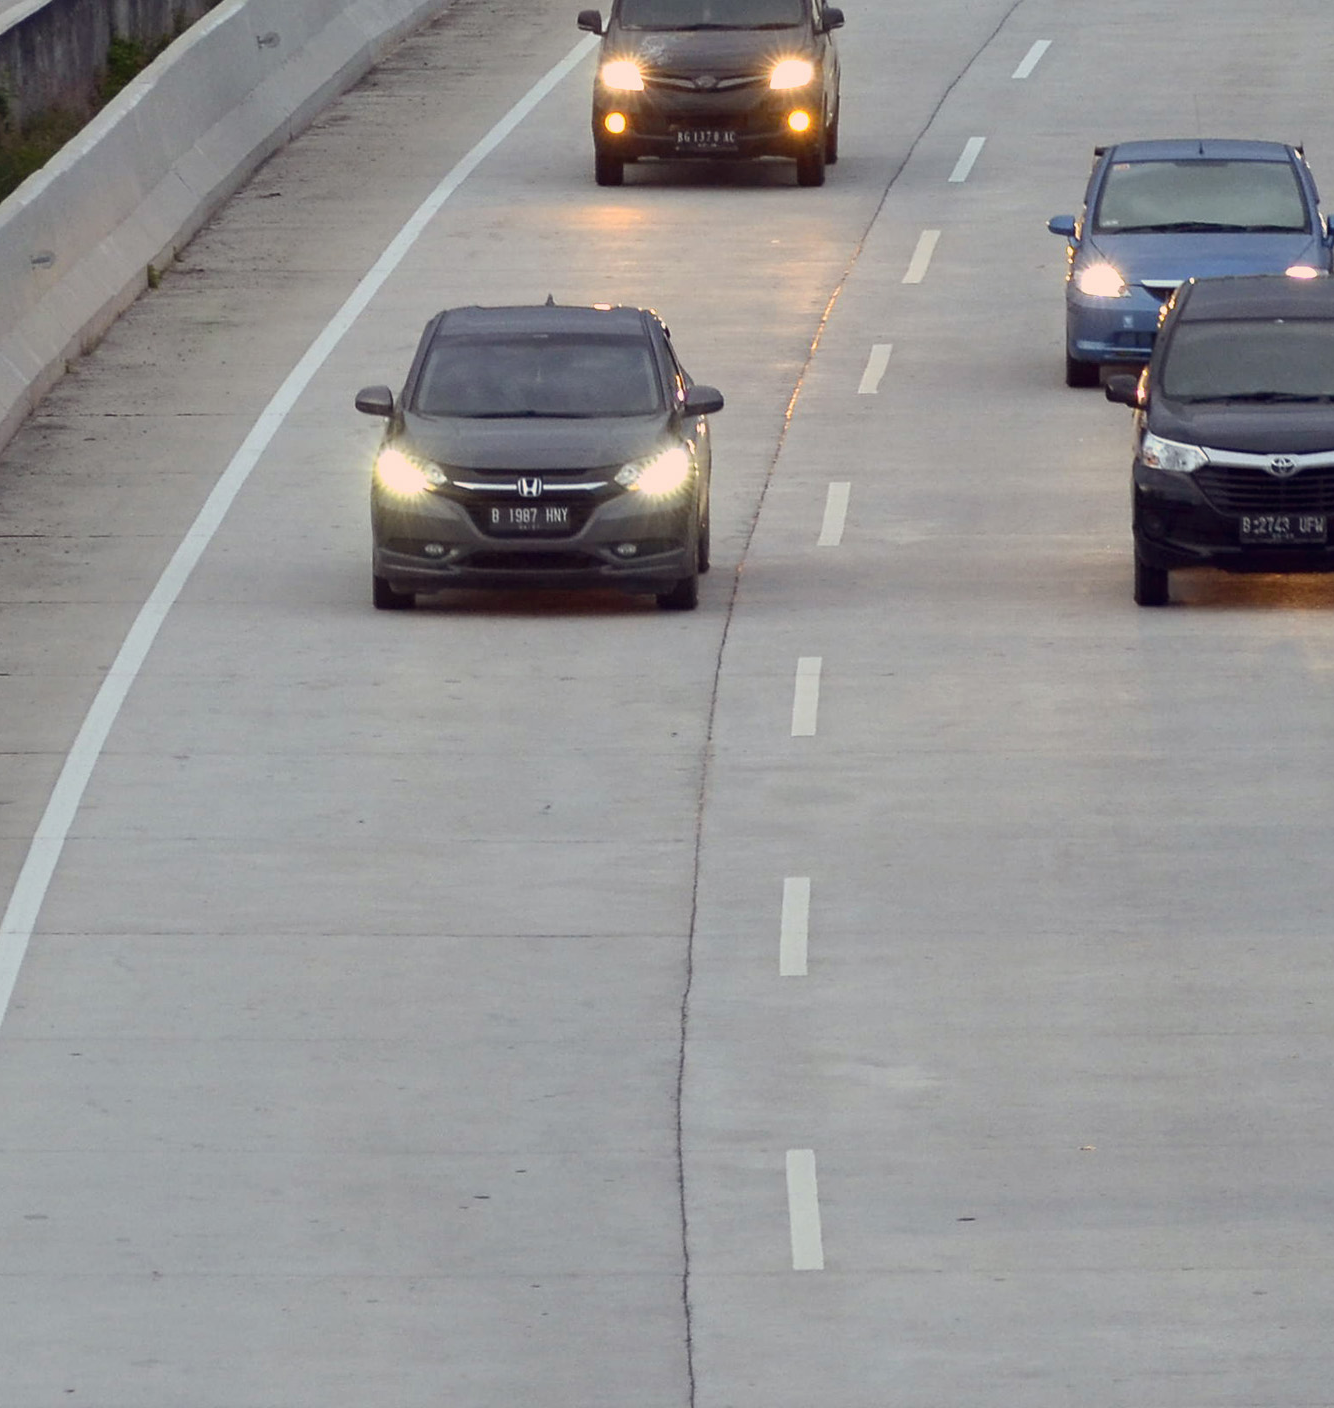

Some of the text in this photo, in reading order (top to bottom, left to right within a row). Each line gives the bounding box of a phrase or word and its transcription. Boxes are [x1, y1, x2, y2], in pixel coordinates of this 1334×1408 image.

[491, 506, 568, 524] B 1987 HNY
